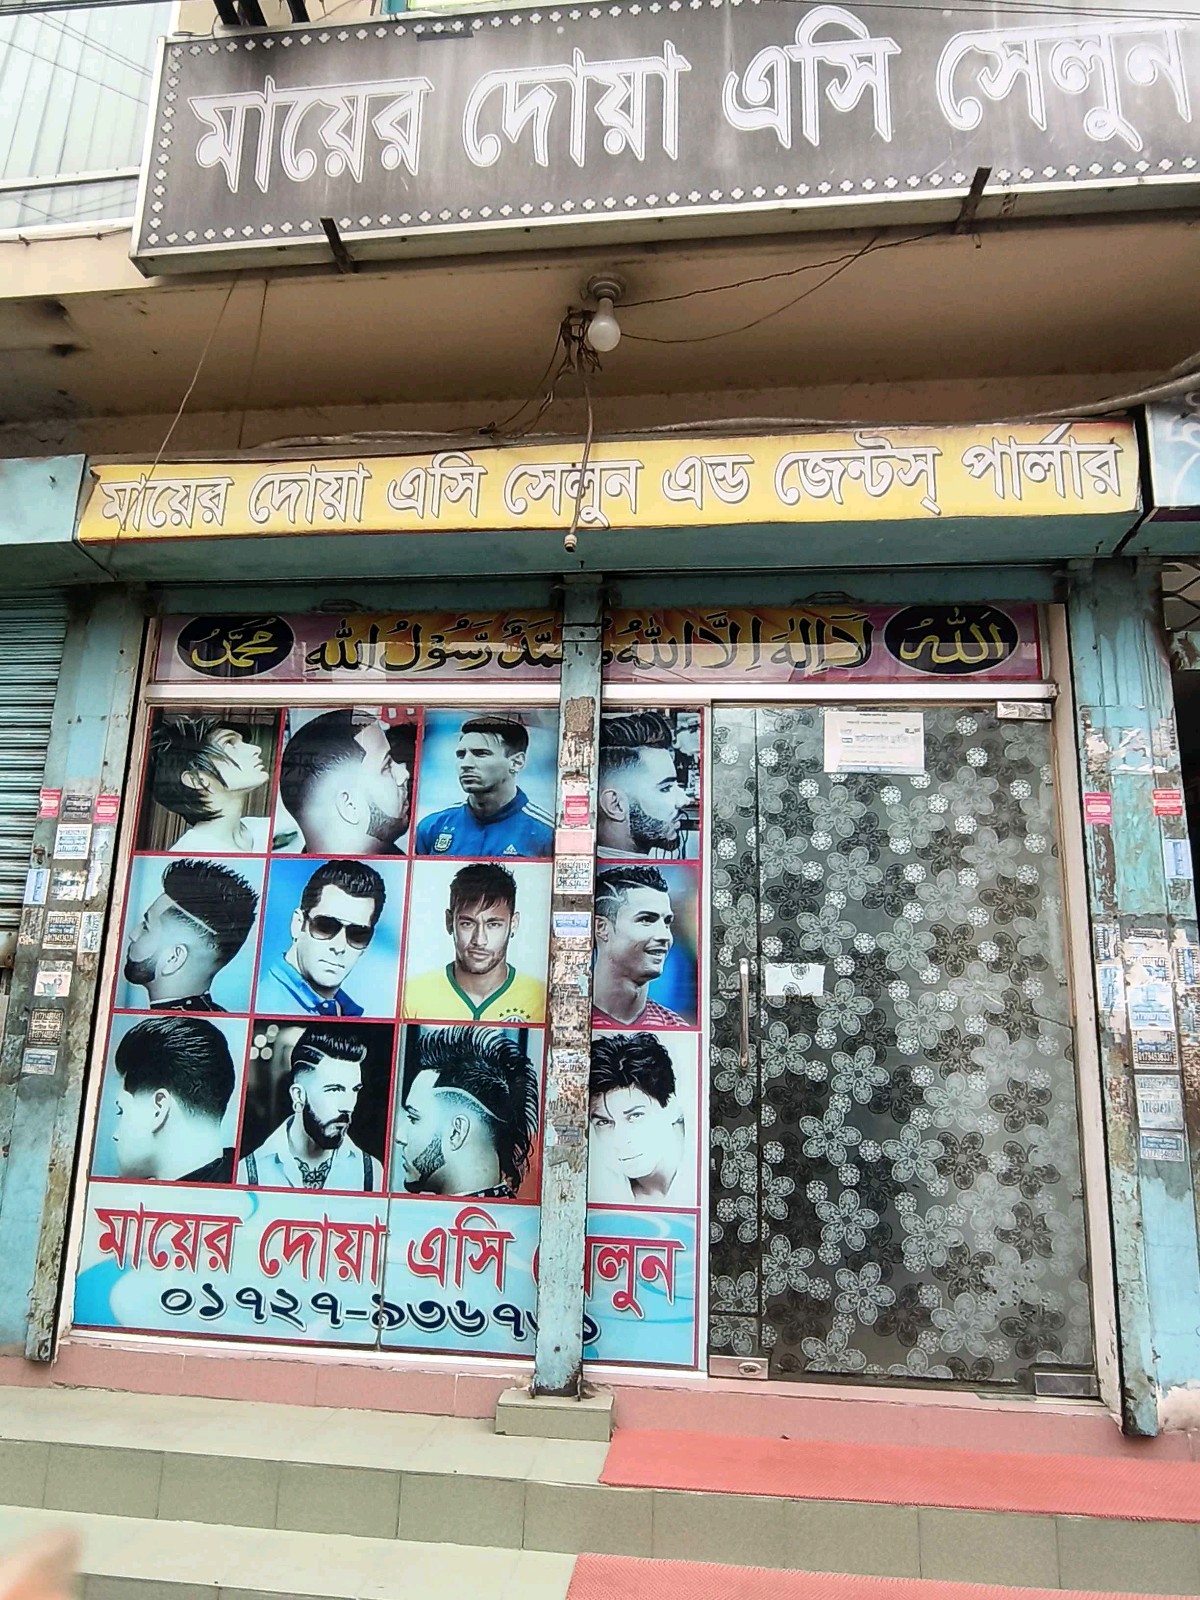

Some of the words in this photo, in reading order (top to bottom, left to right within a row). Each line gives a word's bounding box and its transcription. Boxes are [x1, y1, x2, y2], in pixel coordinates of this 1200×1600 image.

[188, 75, 435, 193] মায়ের
[461, 40, 692, 168] দোয়া
[722, 4, 902, 150] এসি
[935, 19, 1192, 152] সেলুন
[98, 473, 235, 532] মায়ের
[248, 463, 372, 525] দোয়া
[387, 449, 488, 520] এসি
[503, 458, 644, 529] সেলুন
[961, 423, 1124, 501] পার্লার
[93, 1202, 244, 1275] মায়ের
[258, 1213, 390, 1286] দোয়া
[406, 1206, 516, 1293] এসি
